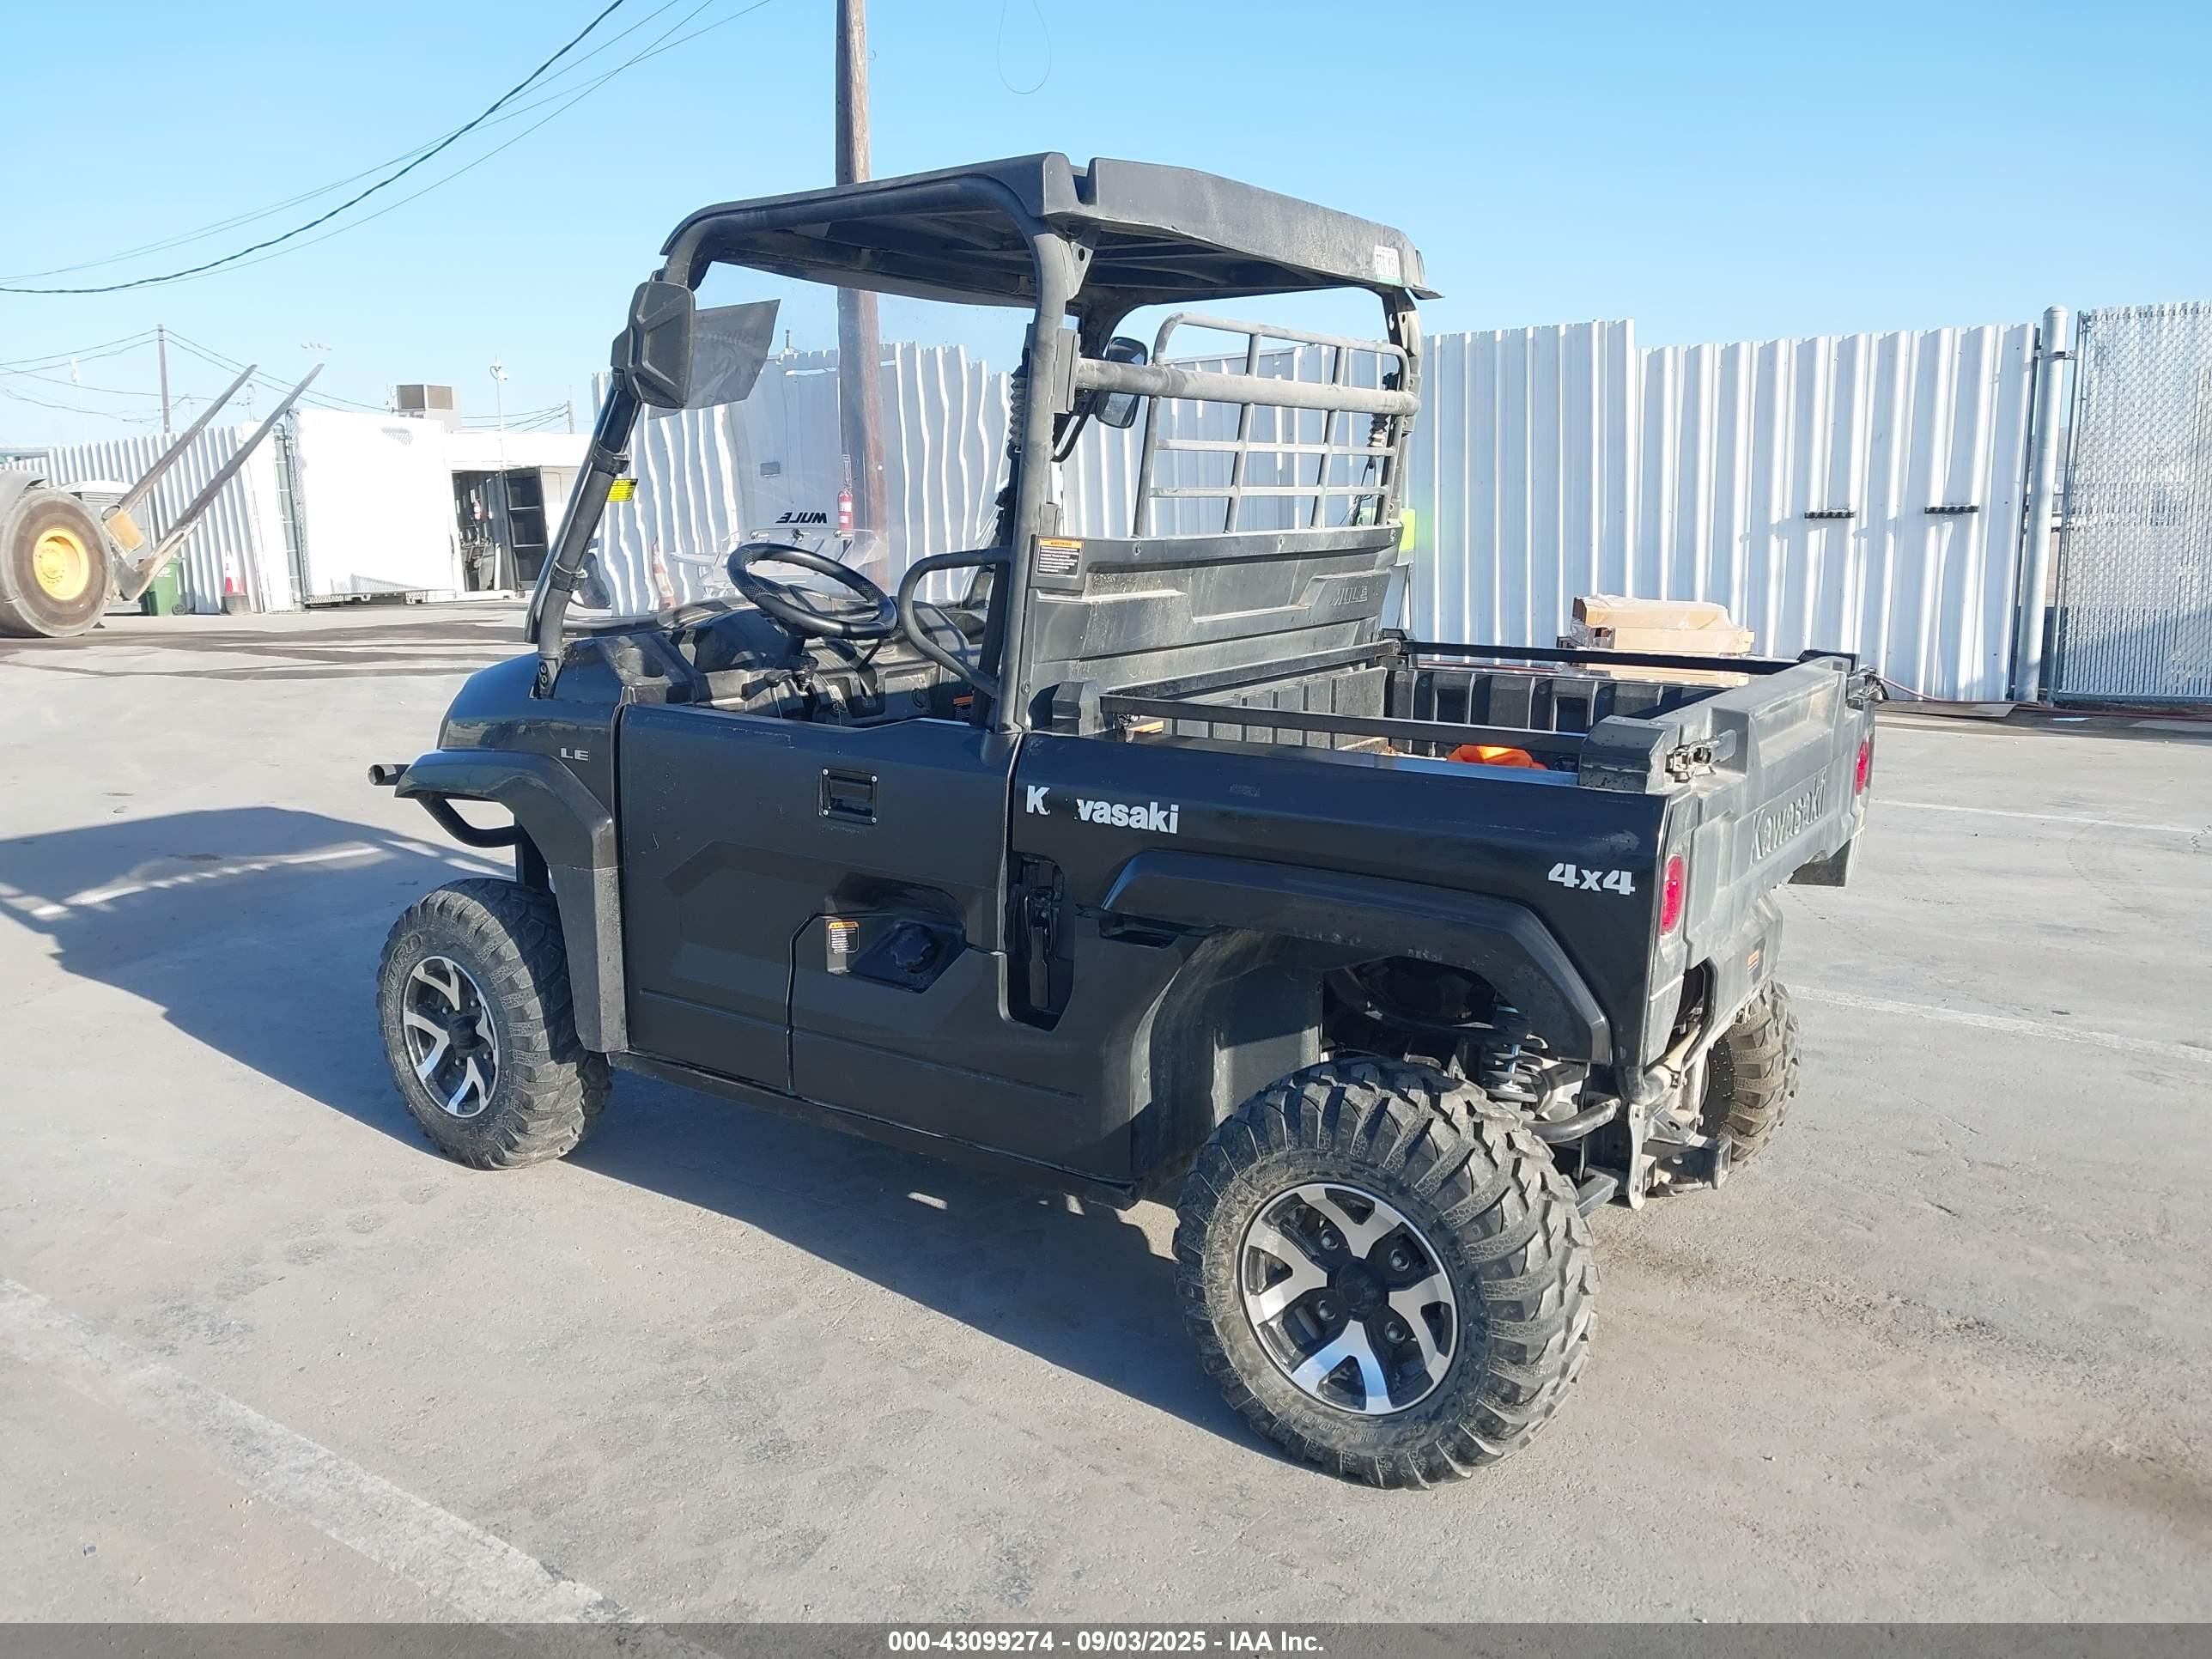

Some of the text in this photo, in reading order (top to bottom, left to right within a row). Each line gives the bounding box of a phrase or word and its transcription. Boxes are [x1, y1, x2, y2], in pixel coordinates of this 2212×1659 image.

[1328, 585, 1368, 606] MULE
[560, 747, 589, 762] LE
[1750, 766, 1827, 865] Kawasaki
[1547, 862, 1636, 896] 4x4
